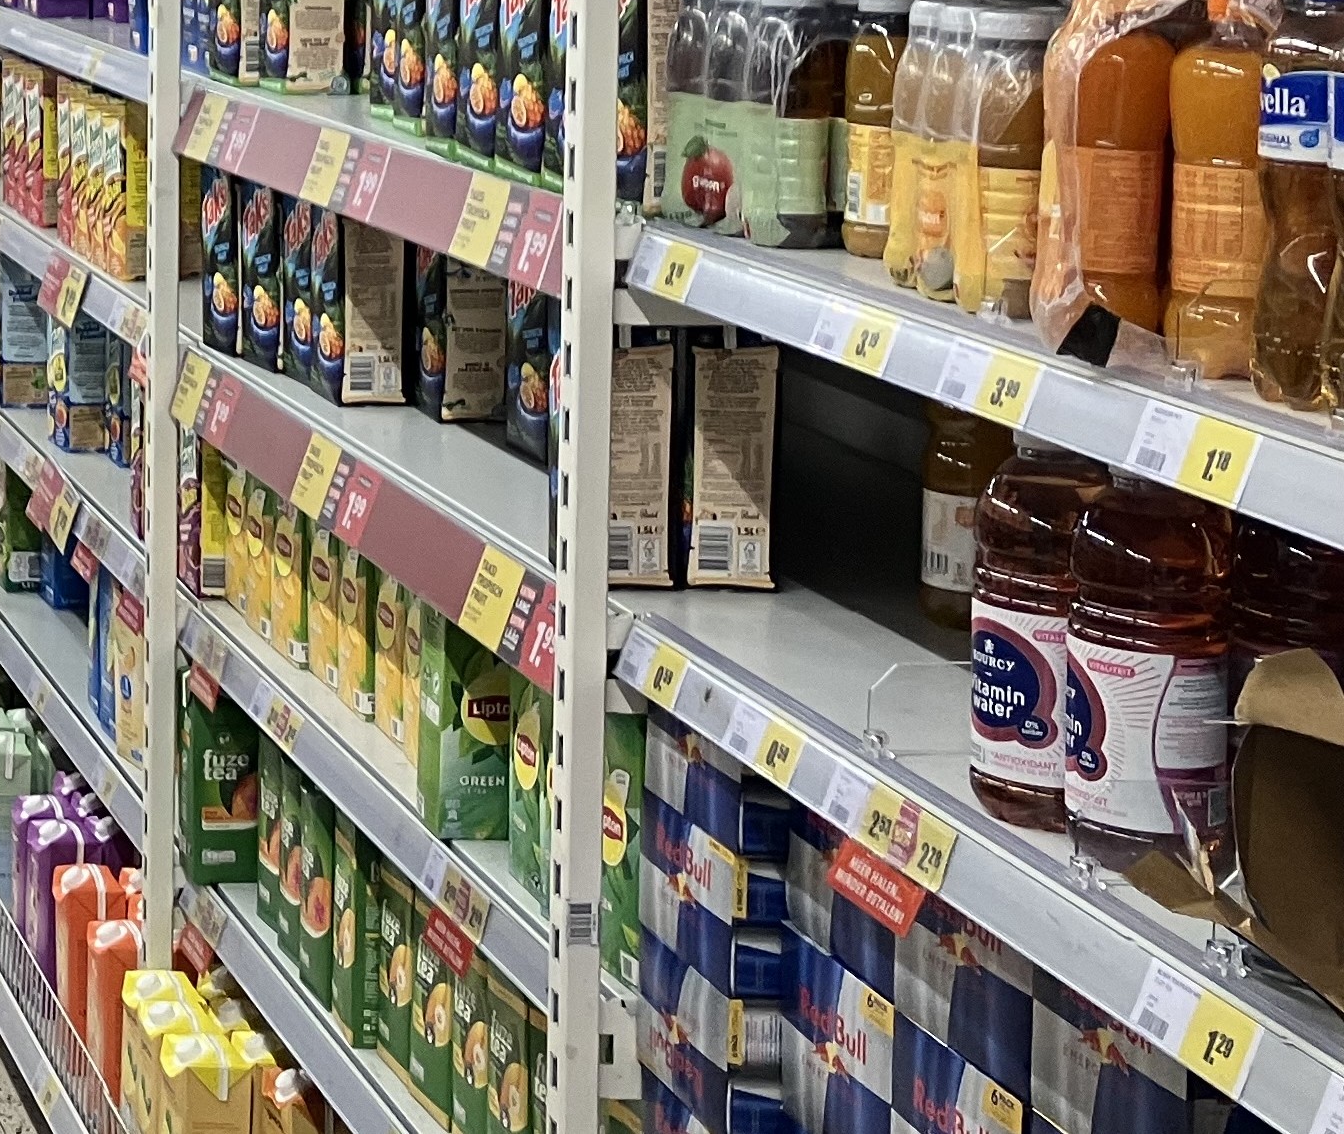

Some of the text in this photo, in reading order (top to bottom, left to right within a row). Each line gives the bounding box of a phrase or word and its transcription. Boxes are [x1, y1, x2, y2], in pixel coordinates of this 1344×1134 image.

[1261, 87, 1307, 118] ella
[517, 228, 549, 274] 1.99
[990, 376, 1021, 407] 3.99
[341, 490, 367, 530] 1.99
[473, 701, 510, 717] Lipto
[972, 693, 1015, 719] water
[203, 748, 250, 768] fuze
[204, 765, 238, 781] tea
[459, 775, 506, 787] GREEN
[602, 811, 624, 841] pton
[849, 854, 871, 877] MEER
[916, 841, 943, 874] 2.28
[835, 1015, 868, 1067] Bull
[1202, 1030, 1235, 1066] 1.29
